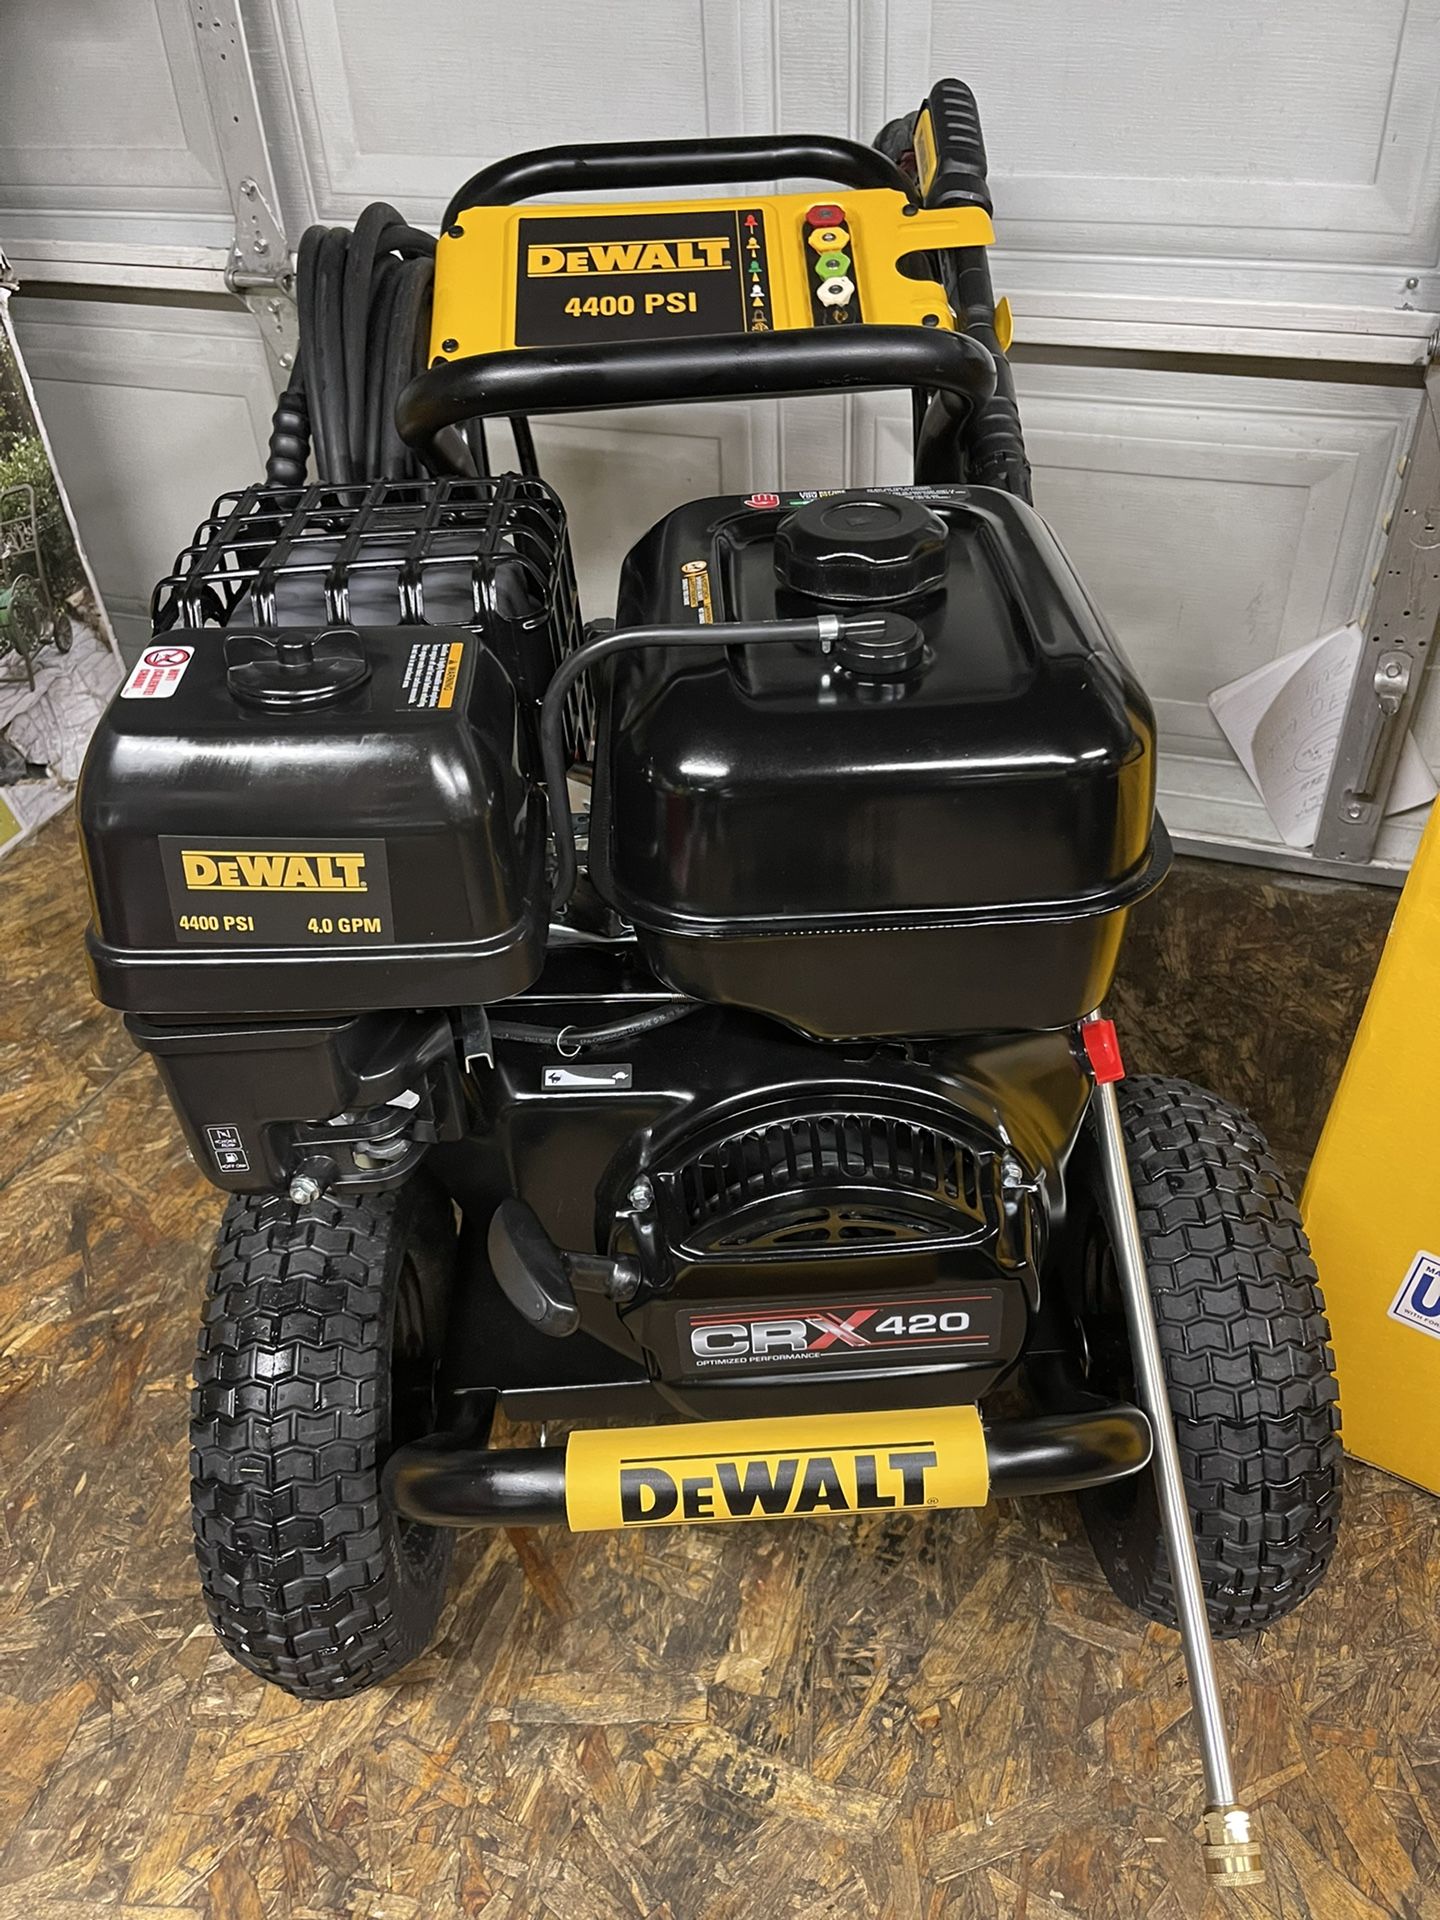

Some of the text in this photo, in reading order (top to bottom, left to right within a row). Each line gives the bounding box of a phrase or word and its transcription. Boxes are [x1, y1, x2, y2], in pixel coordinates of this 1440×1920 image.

[527, 240, 730, 275] DEWALT
[565, 292, 697, 317] 4400 PSI
[181, 853, 367, 889] DEWALT
[180, 915, 381, 933] 4400 PSI 4.0 GPM
[1404, 1309, 1423, 1320] WITH
[690, 1309, 970, 1357] CRX 420
[696, 1352, 821, 1367] OPTIMIZED PERFORMANCE
[619, 1451, 938, 1523] DEWALT
